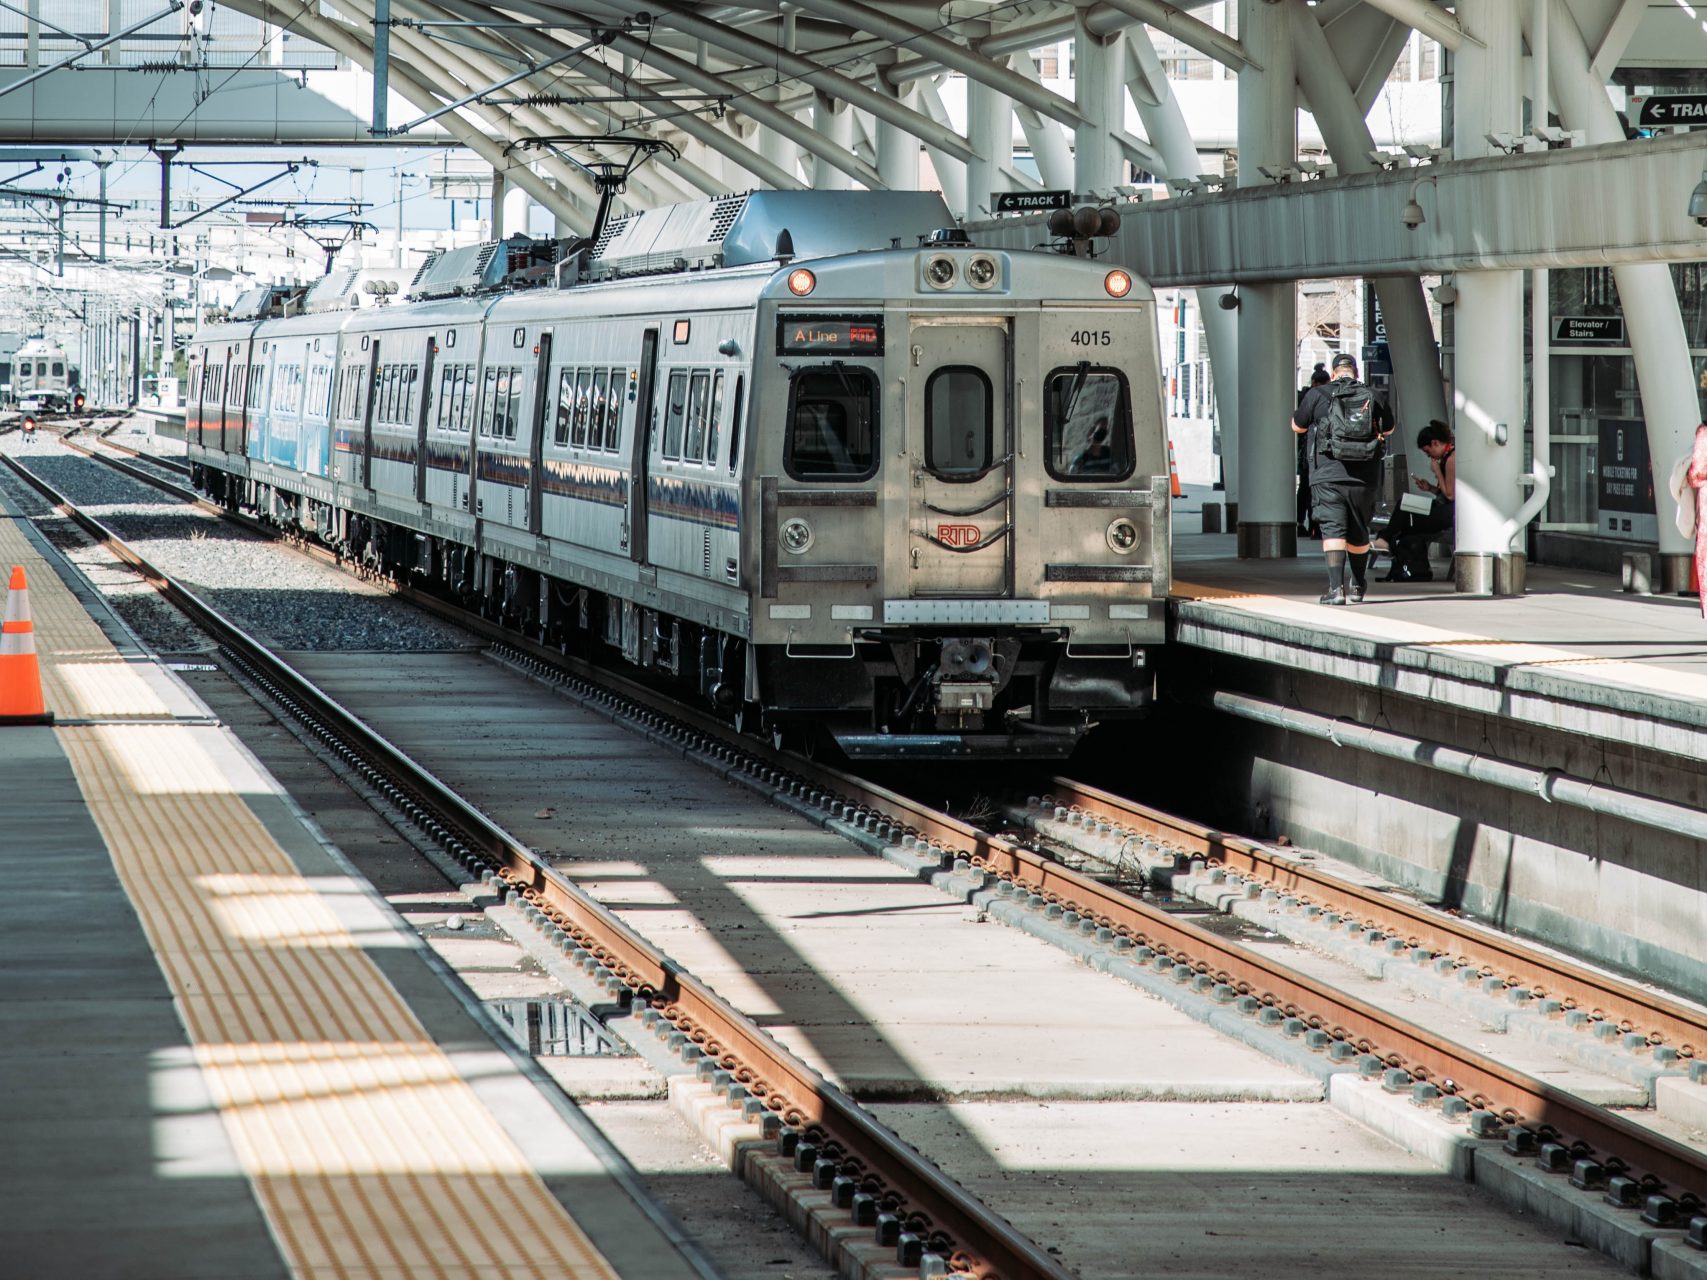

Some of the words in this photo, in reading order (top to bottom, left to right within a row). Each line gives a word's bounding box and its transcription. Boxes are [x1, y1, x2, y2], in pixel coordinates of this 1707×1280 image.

[1671, 103, 1707, 117] TRA
[1017, 196, 1054, 206] TRACK
[1060, 194, 1065, 205] 1
[1569, 320, 1604, 328] Elevator
[795, 329, 806, 342] A
[808, 330, 838, 343] Line
[1070, 330, 1111, 346] 4015
[1569, 329, 1594, 337] Stairs
[937, 524, 981, 546] RTD
